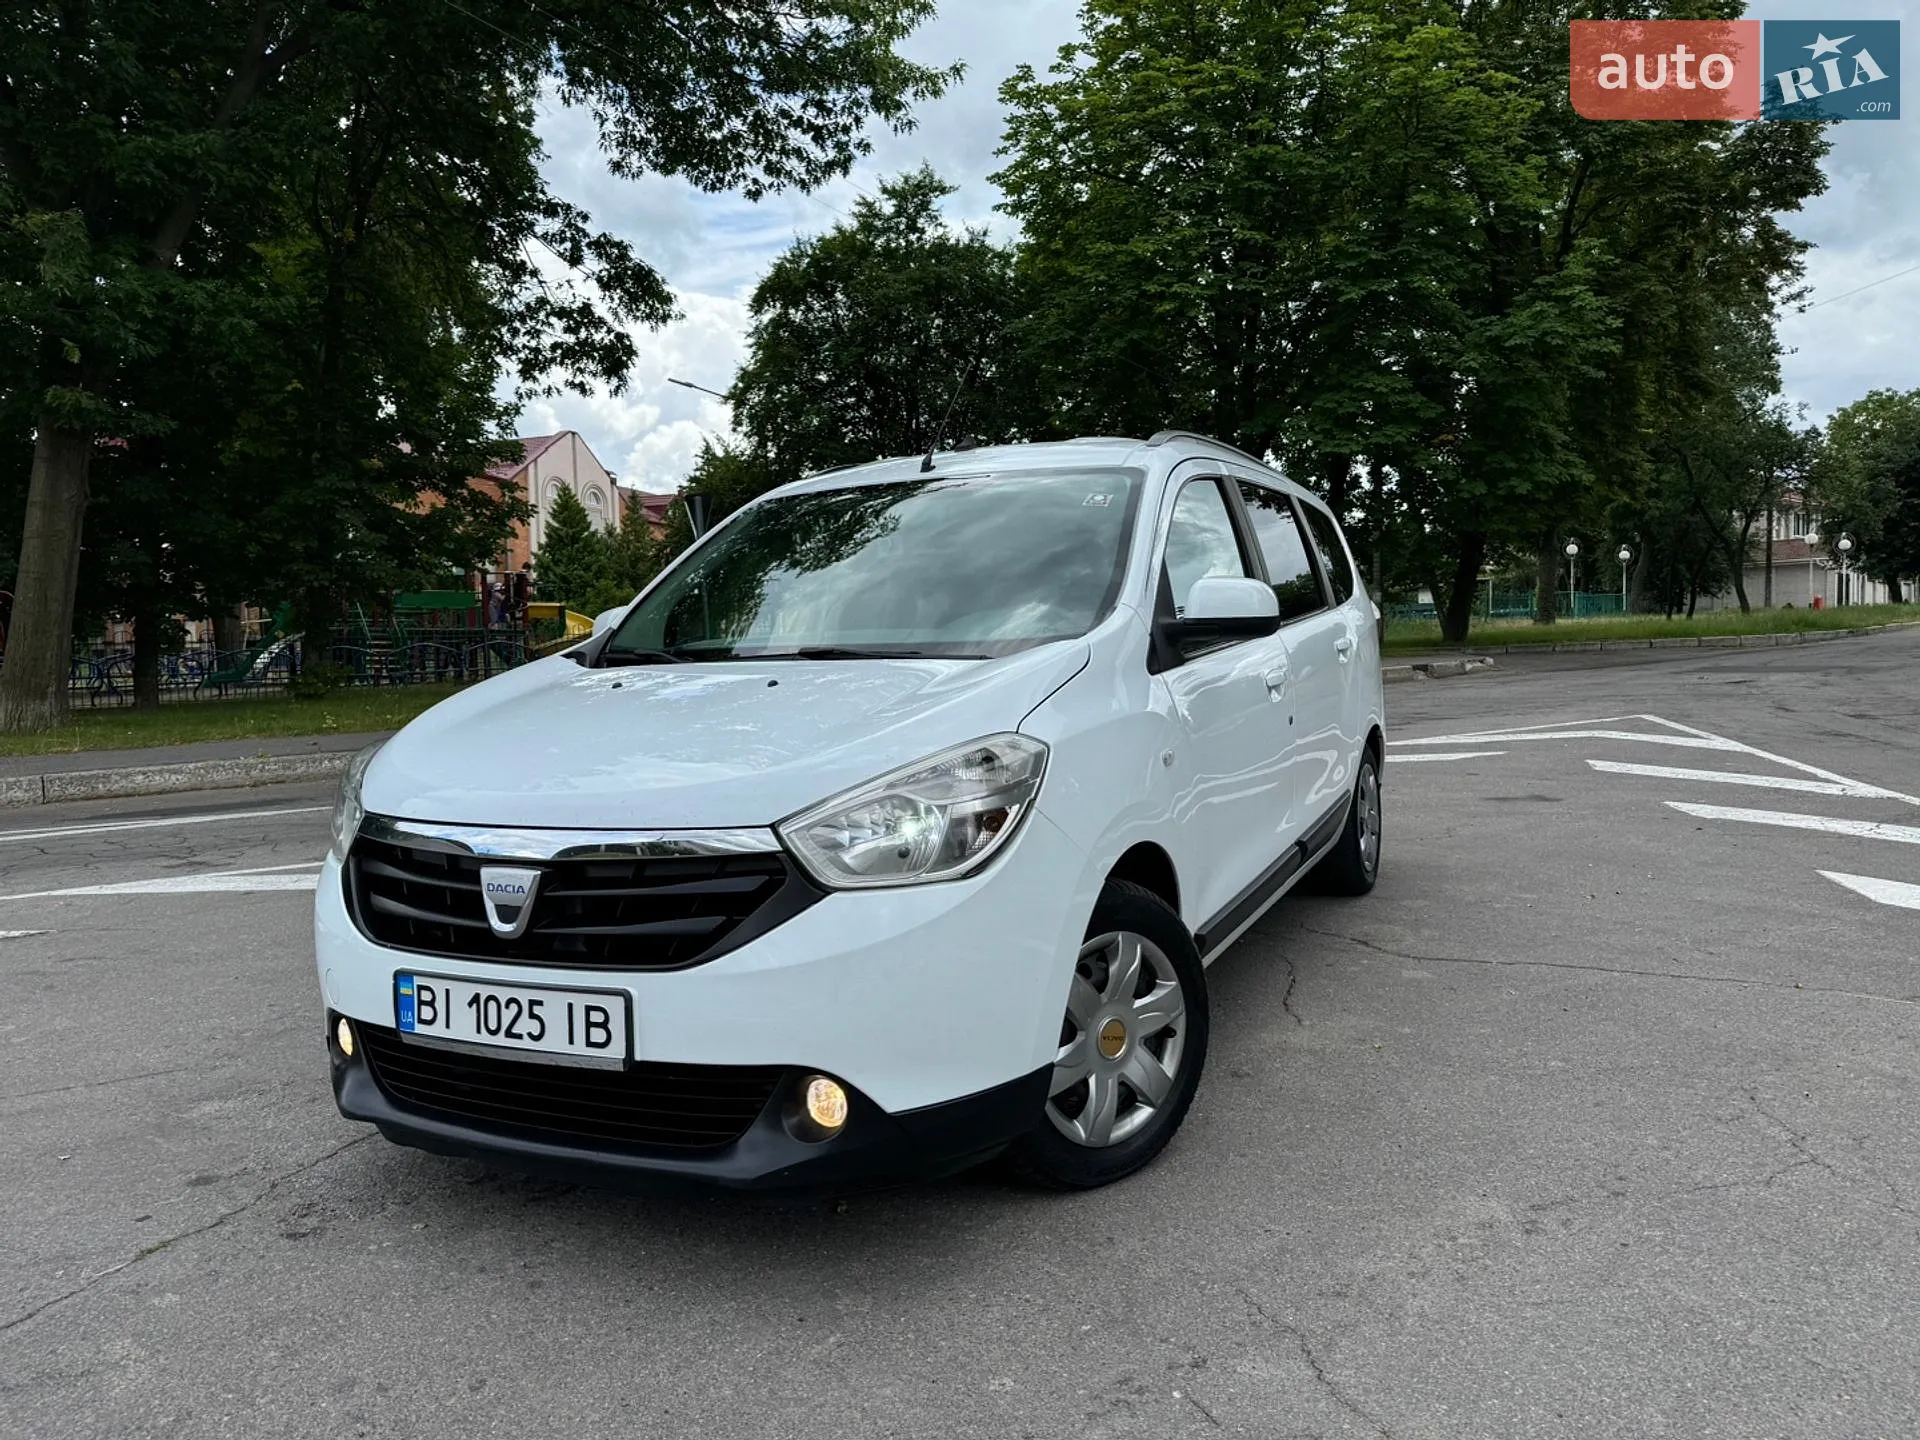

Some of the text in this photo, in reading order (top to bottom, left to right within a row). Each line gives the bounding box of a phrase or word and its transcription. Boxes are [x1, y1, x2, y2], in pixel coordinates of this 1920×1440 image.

[486, 882, 526, 894] DACIA
[401, 1009, 414, 1024] UA
[416, 984, 612, 1049] BI 1025 IB
